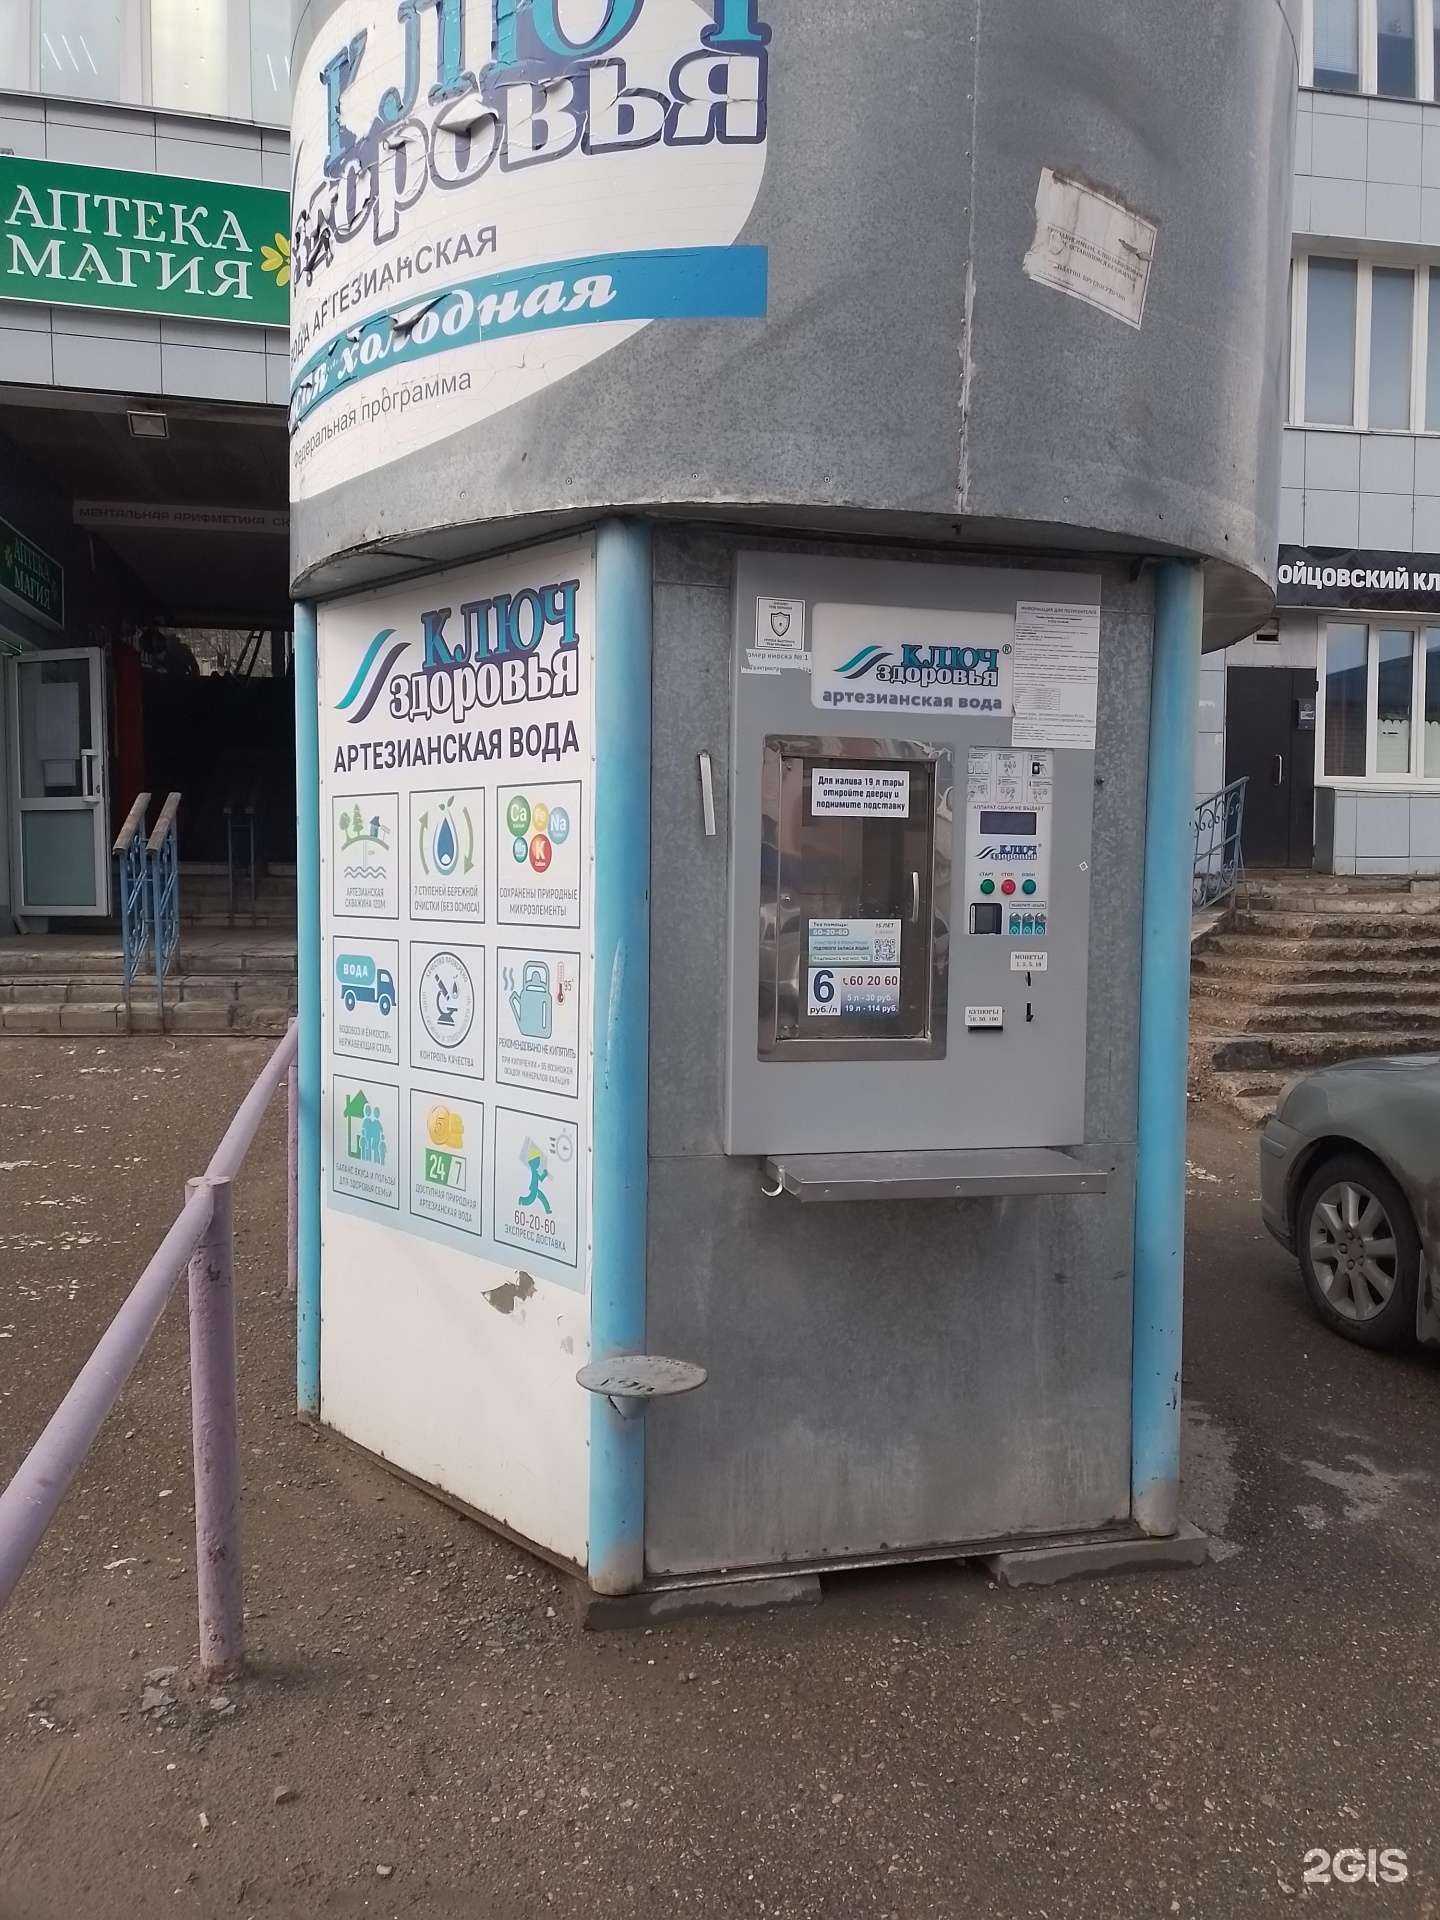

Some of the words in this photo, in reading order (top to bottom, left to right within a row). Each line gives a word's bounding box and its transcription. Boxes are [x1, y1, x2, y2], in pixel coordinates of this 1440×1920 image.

[4, 184, 253, 252] АПТЕКА
[5, 234, 253, 299] МАГИЯ
[361, 371, 471, 422] программа
[79, 507, 170, 521] МЕНТАЛЬНАЯ
[173, 512, 265, 526] АРИФМЕТИКА
[421, 579, 580, 670] КЛЮЧ
[900, 643, 999, 670] КЛЮЧ
[822, 688, 954, 709] артезианская
[958, 695, 1002, 710] вода
[333, 728, 503, 773] АРТЕЗИАНСКАЯ
[509, 720, 580, 762] ВОДА
[818, 776, 833, 785] Для
[835, 777, 862, 786] налива
[865, 777, 873, 786] 19
[882, 779, 904, 788] тары
[823, 788, 863, 798] откройте
[866, 790, 892, 799] дверцу
[816, 801, 861, 809] поднимите
[863, 802, 905, 811] подставку
[551, 815, 567, 832] Na
[537, 888, 578, 901] ПРИРОДНЫЕ
[414, 901, 440, 911] ОЧИСТКИ
[509, 903, 567, 916] МИКРОЭЛЕМЕНТЫ
[343, 963, 368, 978] ВОДА
[849, 975, 864, 986] 60
[867, 975, 881, 986] 20
[884, 975, 898, 986] 60
[813, 969, 835, 1003] 6
[428, 1153, 446, 1181] 24
[454, 1160, 462, 1185] 7
[514, 1209, 556, 1236] 60-20-60
